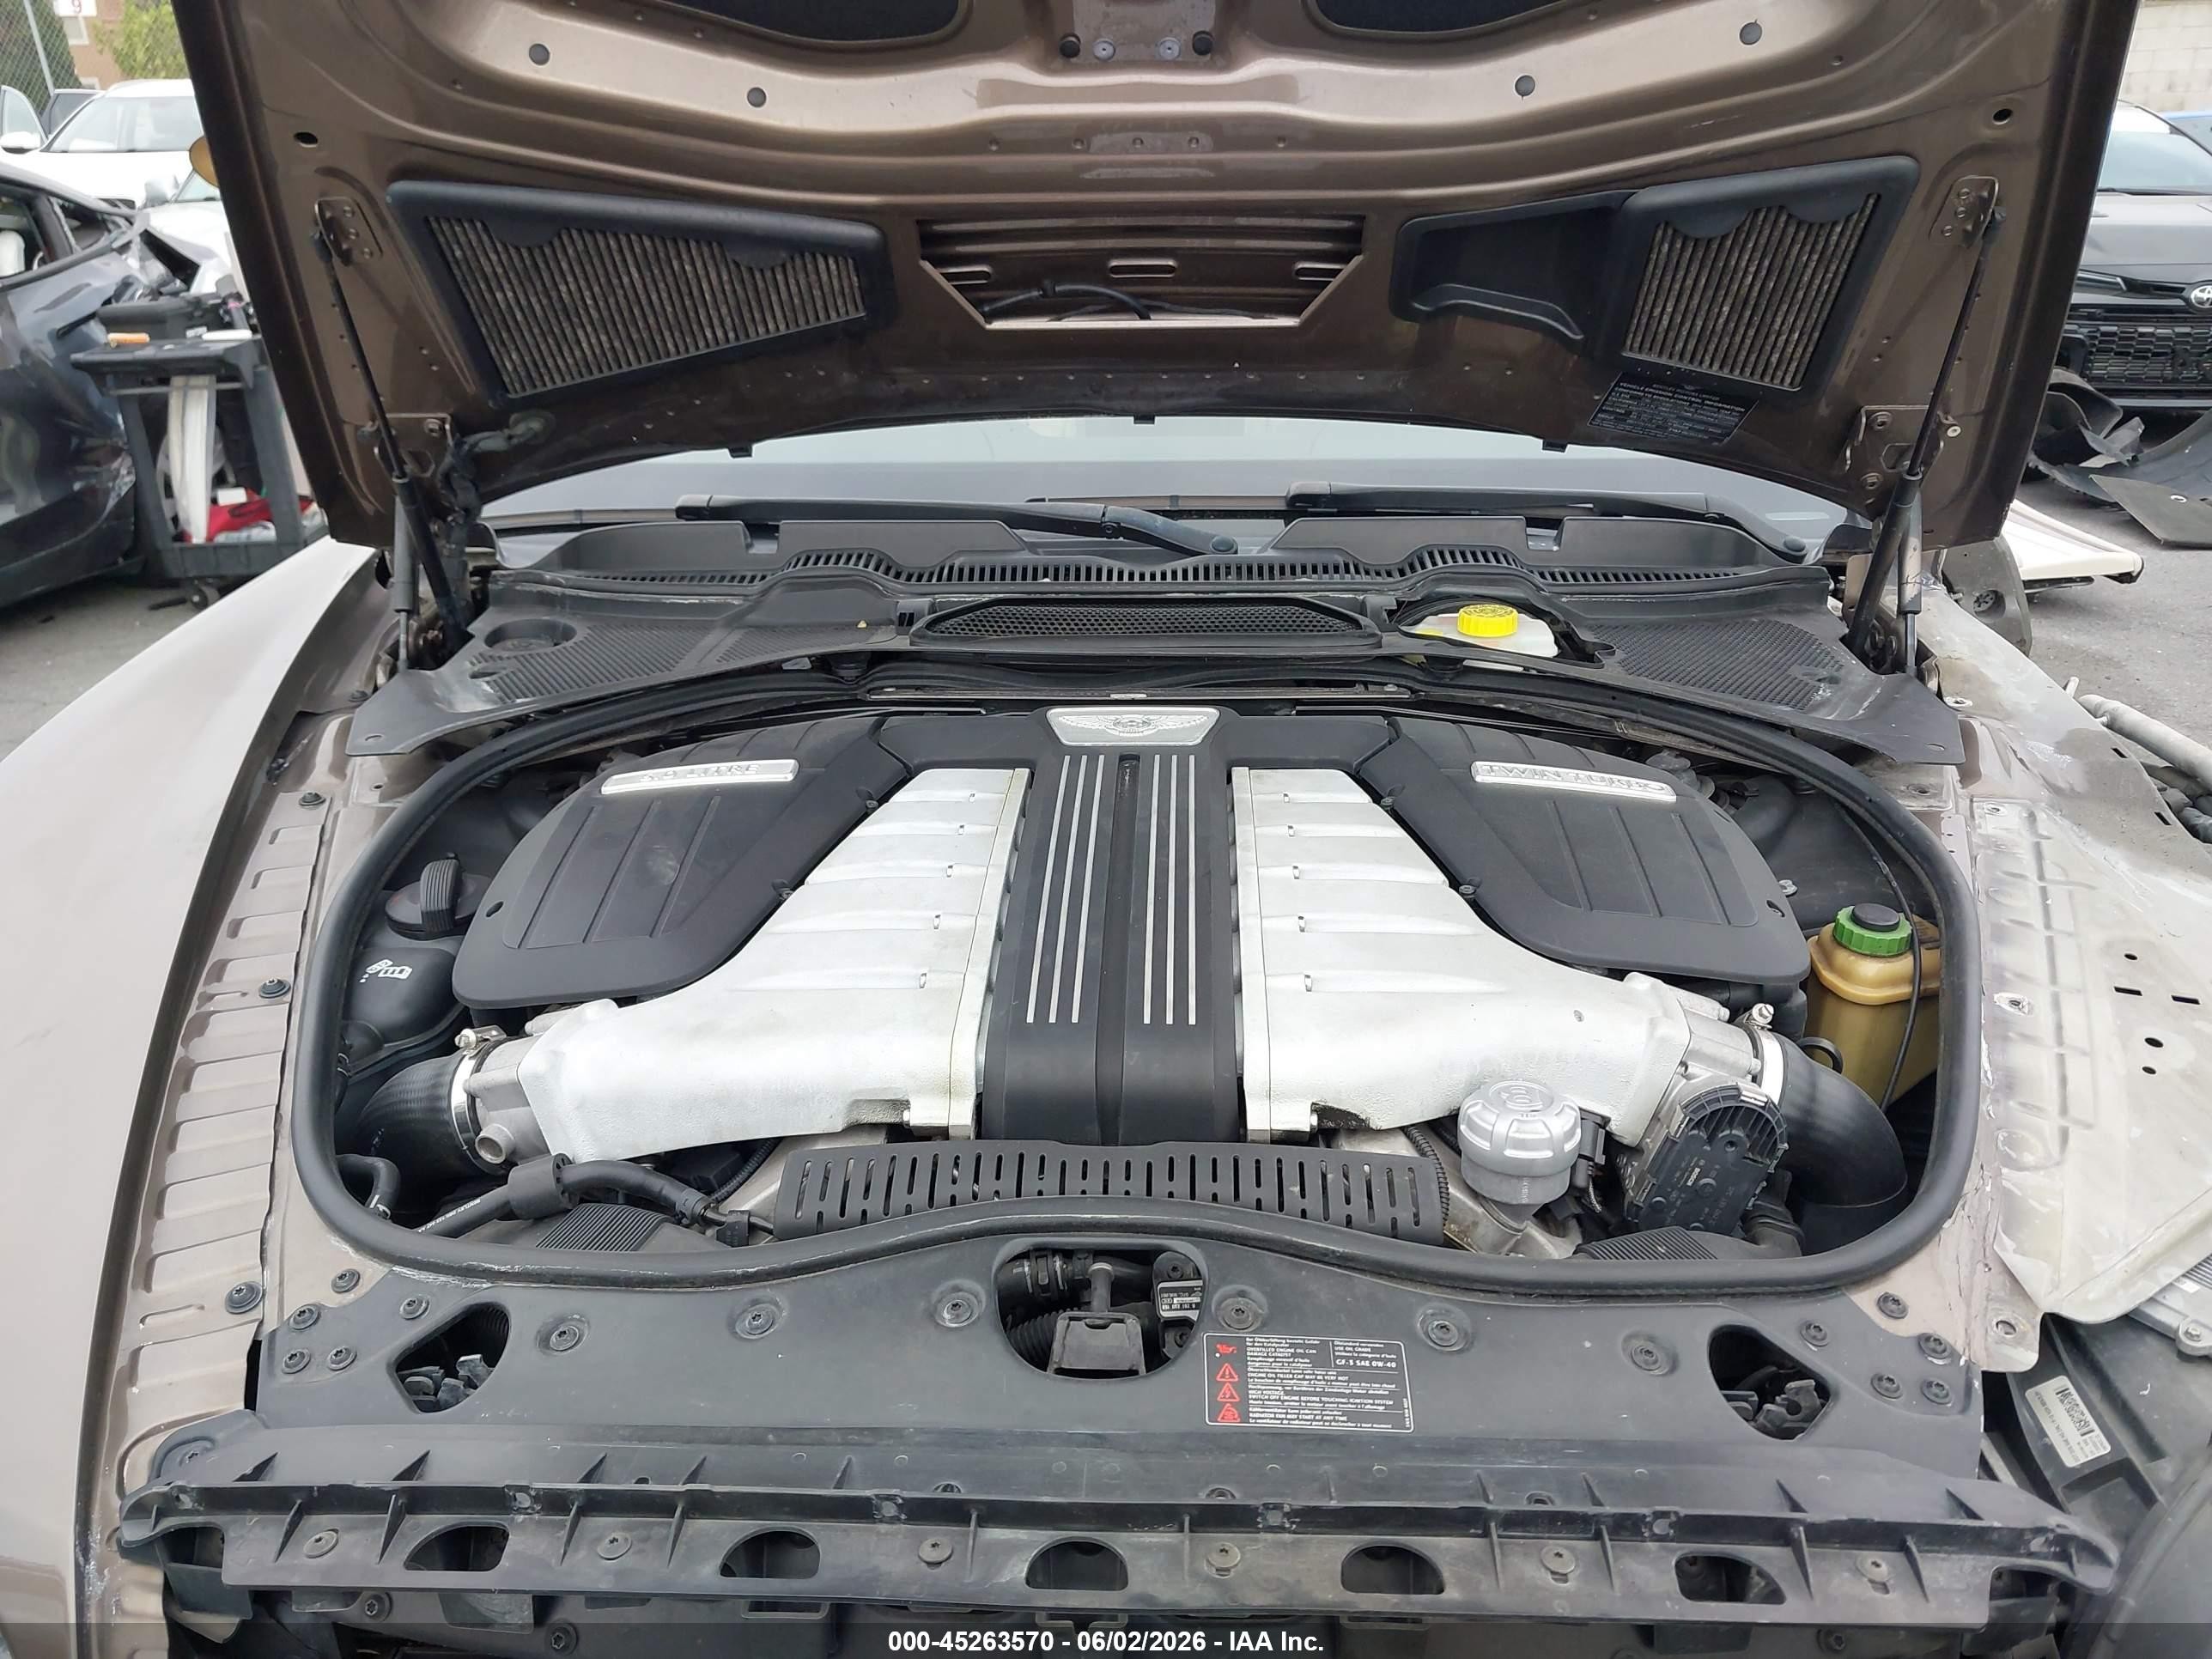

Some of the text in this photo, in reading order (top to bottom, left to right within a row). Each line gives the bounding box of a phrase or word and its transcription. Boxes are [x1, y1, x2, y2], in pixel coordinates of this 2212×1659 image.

[687, 764, 761, 778] LITRE
[1482, 764, 1665, 791] TWIN TURBO
